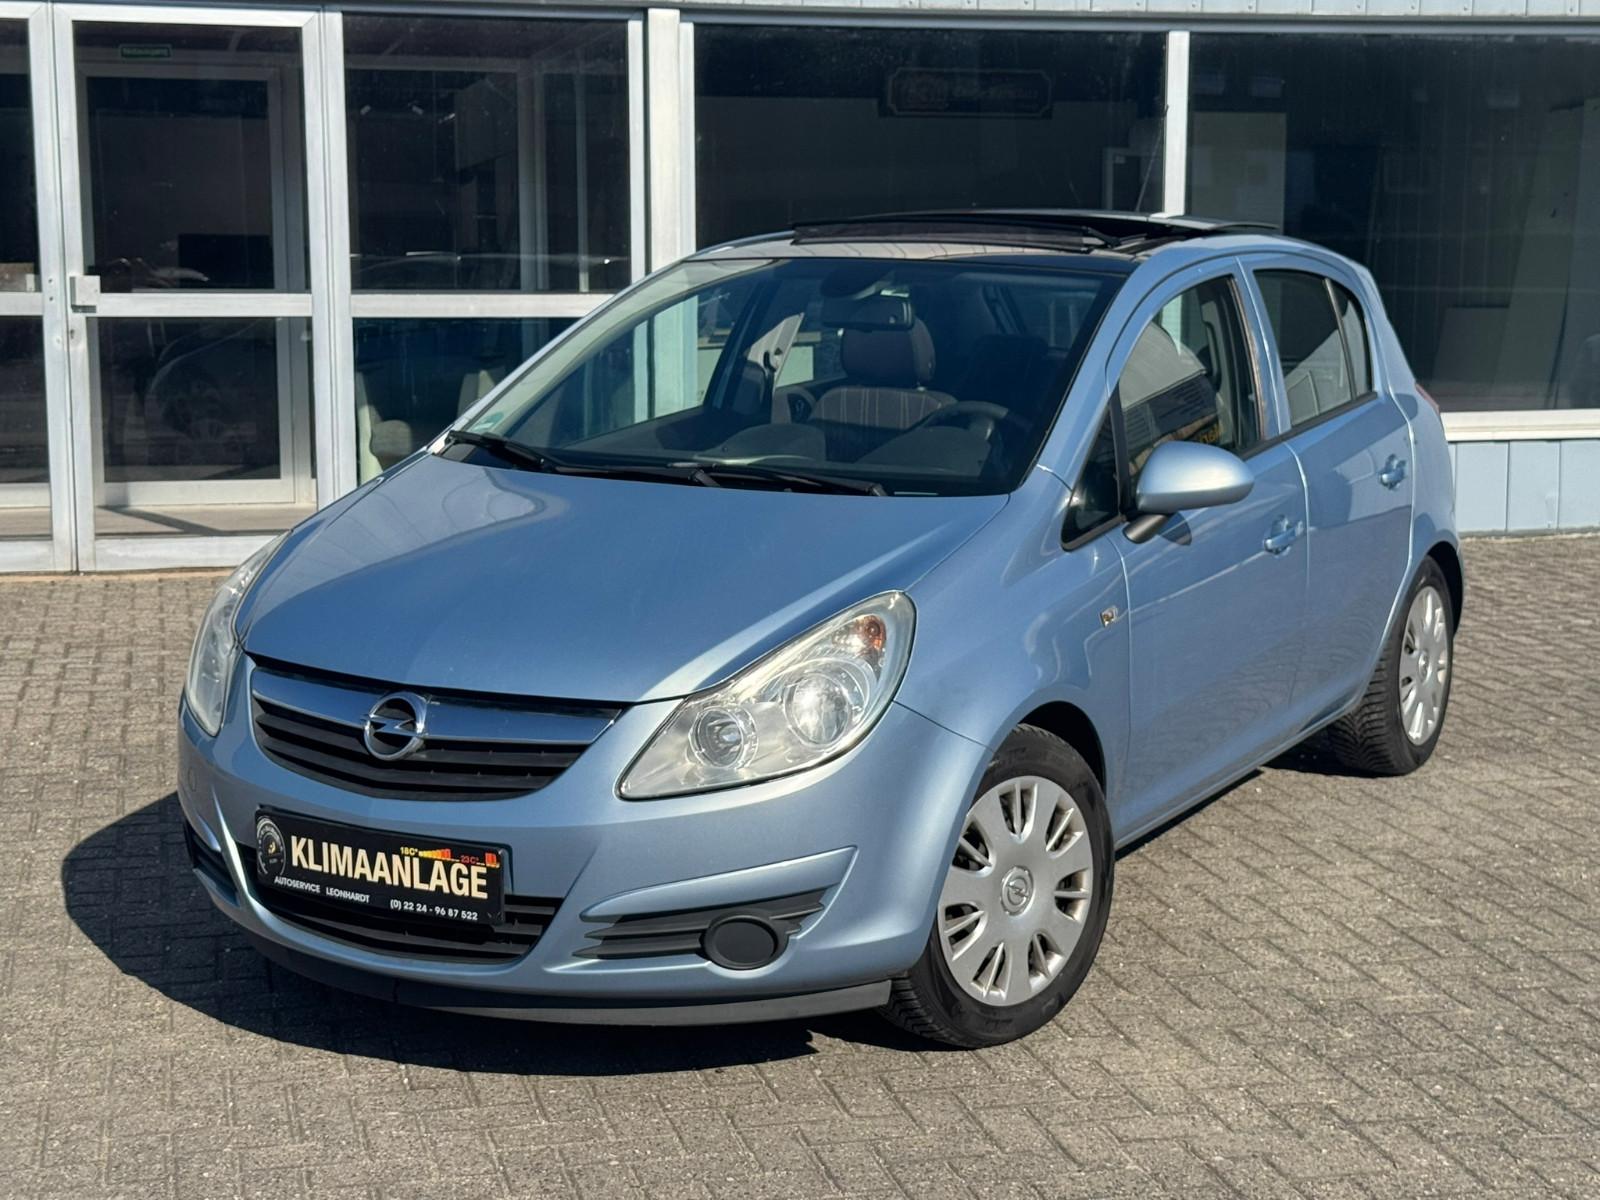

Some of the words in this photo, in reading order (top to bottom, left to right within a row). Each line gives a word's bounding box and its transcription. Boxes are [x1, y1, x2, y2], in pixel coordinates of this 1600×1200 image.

[291, 835, 488, 899] KLIMAANLAGE
[274, 875, 320, 893] AUTOSERVICE
[325, 886, 370, 903] LEONHARDT
[390, 899, 402, 911] (0)
[403, 901, 415, 911] 22
[416, 903, 427, 913] 24
[434, 906, 446, 916] 96
[448, 908, 459, 918] 87
[461, 910, 478, 921] 522
